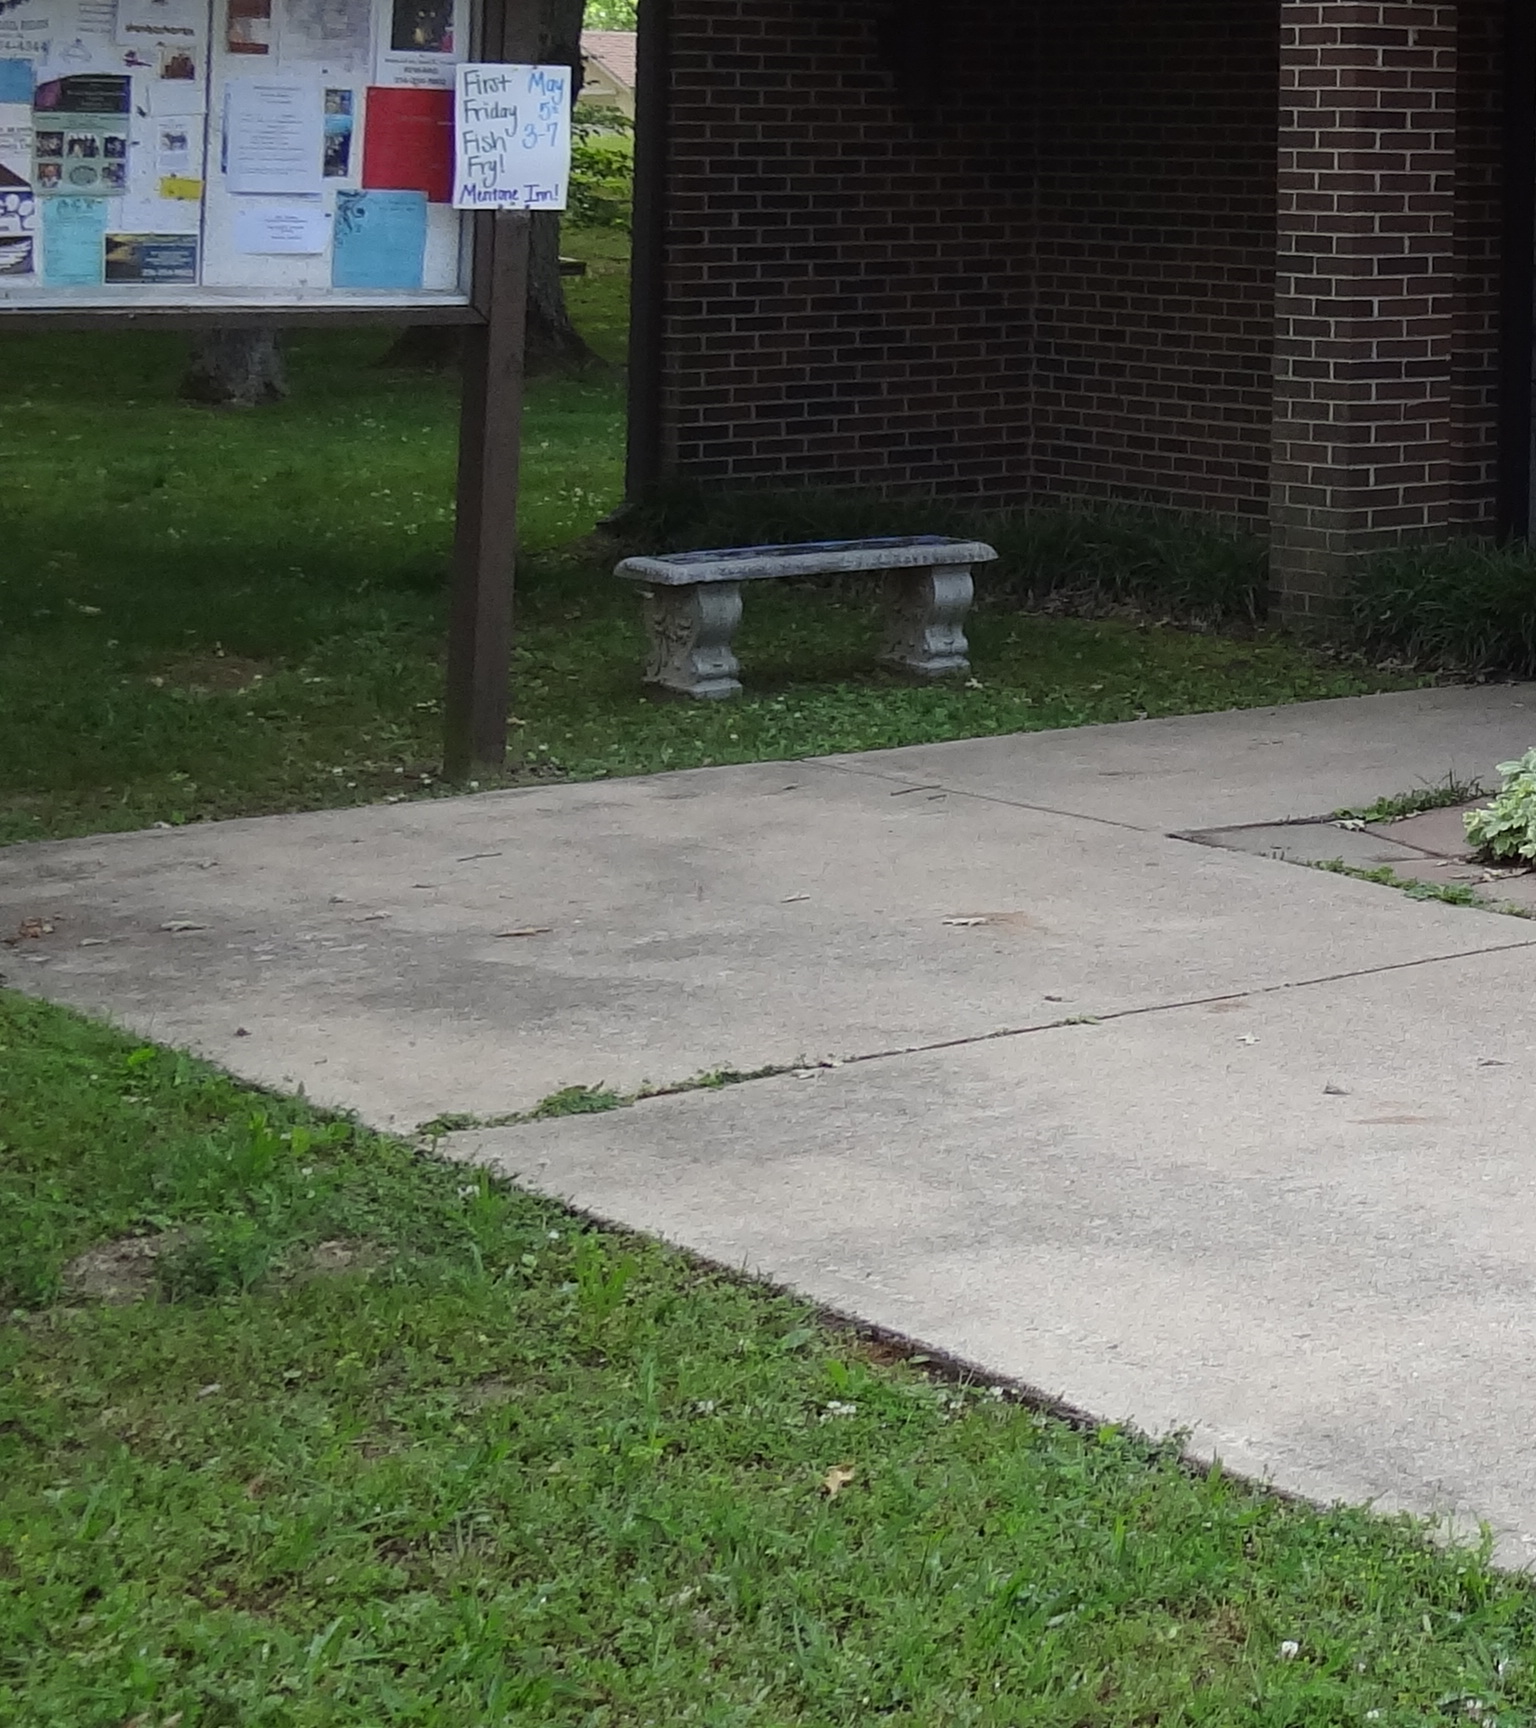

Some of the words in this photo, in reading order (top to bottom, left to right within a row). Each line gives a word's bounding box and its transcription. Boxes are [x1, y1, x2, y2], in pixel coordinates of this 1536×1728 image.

[464, 70, 512, 96] First
[527, 71, 564, 105] May
[463, 99, 517, 137] Friday
[462, 130, 507, 154] Fish
[522, 122, 557, 149] 3-7
[467, 154, 505, 188] Fry!
[459, 183, 518, 204] Mentone
[523, 184, 559, 203] Inn!
